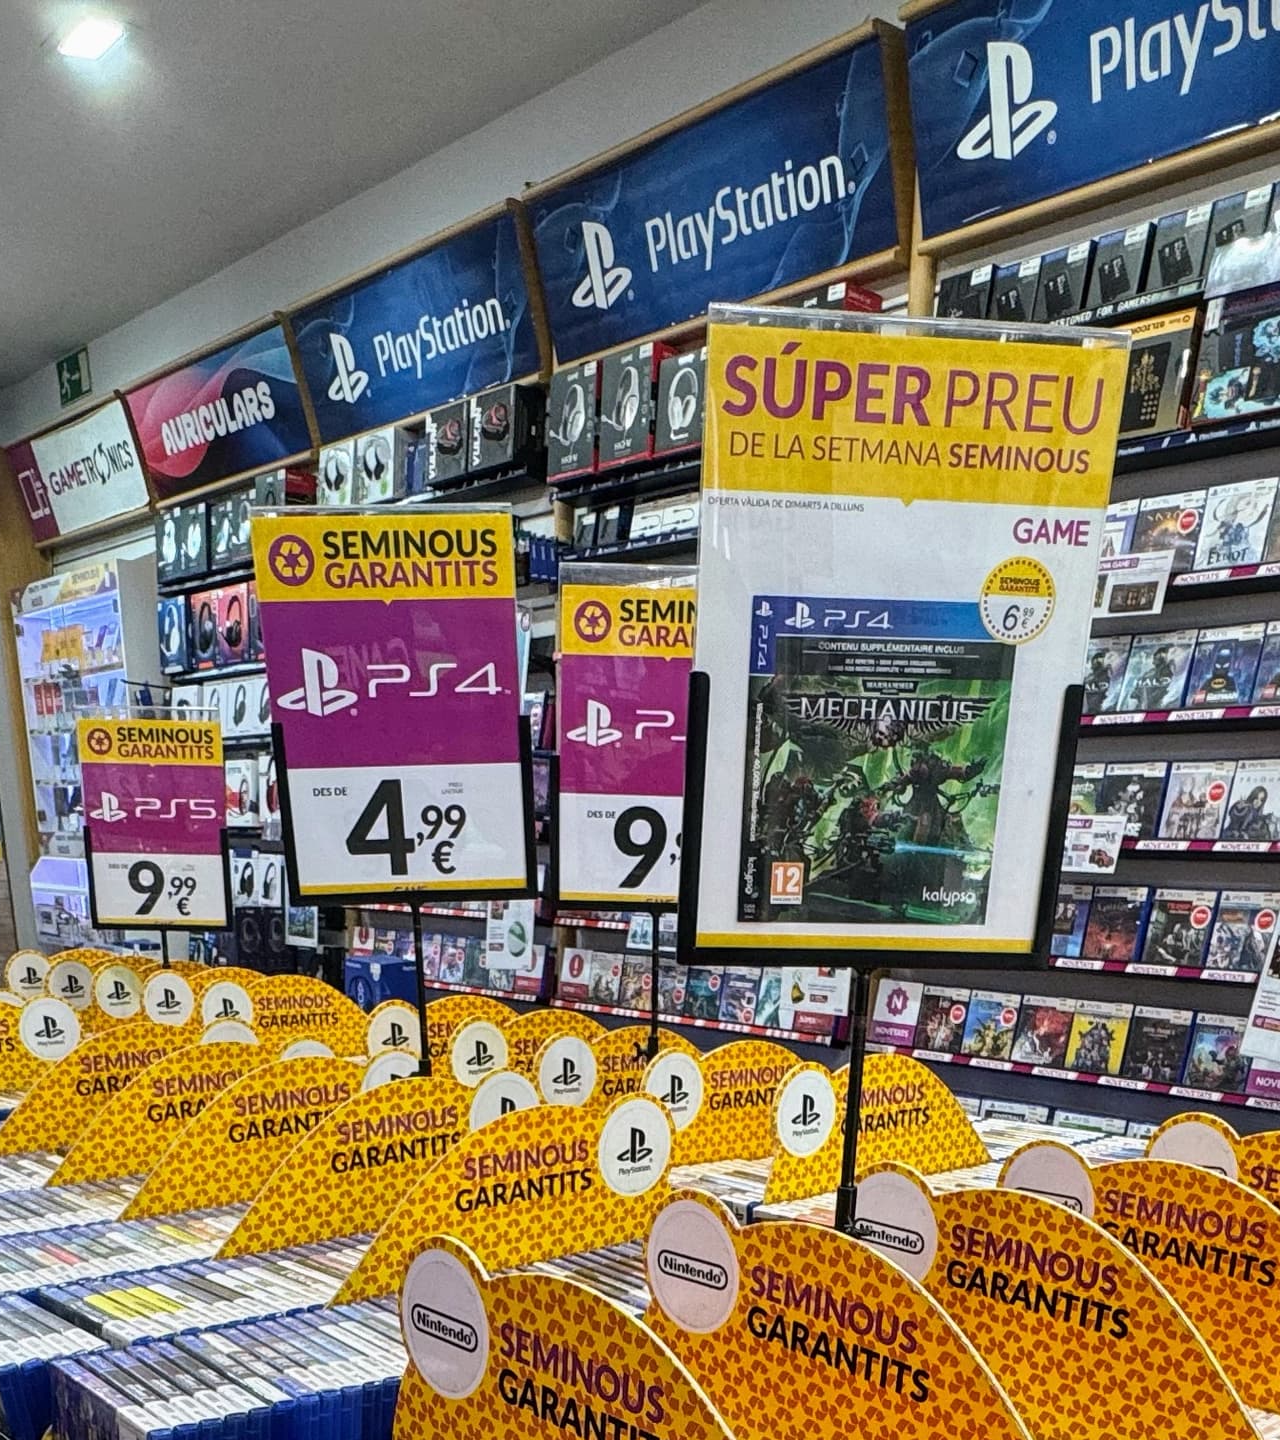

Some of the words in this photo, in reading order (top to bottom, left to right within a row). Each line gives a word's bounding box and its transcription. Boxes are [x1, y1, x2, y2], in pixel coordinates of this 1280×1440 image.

[644, 154, 847, 274] PlayStation
[372, 293, 509, 381] PlayStation
[721, 342, 931, 426] SÚPER
[943, 369, 1104, 435] PREU
[161, 378, 276, 458] AURICULARS
[729, 431, 765, 459] DE
[774, 434, 804, 460] LA
[812, 436, 940, 467] SETMANA
[948, 443, 1090, 474] SEMINOUS
[708, 496, 737, 507] OFERTA
[785, 500, 821, 511] DIMARTS
[830, 503, 865, 513] DILLUNS
[322, 528, 498, 560] SEMINOUS
[1012, 517, 1091, 547] GAME
[324, 559, 499, 590] GARANTITS
[824, 609, 892, 630] PS4
[756, 624, 769, 669] PS4
[818, 641, 859, 652] CONTENU
[861, 642, 933, 654] SUPPLÉMENTAIRE
[934, 644, 965, 655] INCLUS
[366, 661, 503, 699] PS4
[799, 697, 974, 721] MECHANICUS
[116, 725, 214, 748] SEMINOUS
[117, 741, 215, 761] GARANTITS
[134, 797, 216, 818] PS5
[744, 856, 757, 896] kalypso
[774, 866, 802, 894] 12
[922, 886, 976, 907] kalypso
[462, 1138, 590, 1182] SEMINOUS
[454, 1168, 594, 1213] GARANTITS
[1103, 1187, 1268, 1250] SEMINOUS
[662, 1253, 724, 1287] Nintendo
[950, 1222, 1120, 1298] SEMINOUS
[748, 1263, 920, 1356] SEMINOUS
[945, 1258, 1130, 1342] GARANTITS
[415, 1310, 475, 1348] Nintendo
[746, 1305, 932, 1402] GARANTITS
[499, 1321, 668, 1426] SEMINOUS
